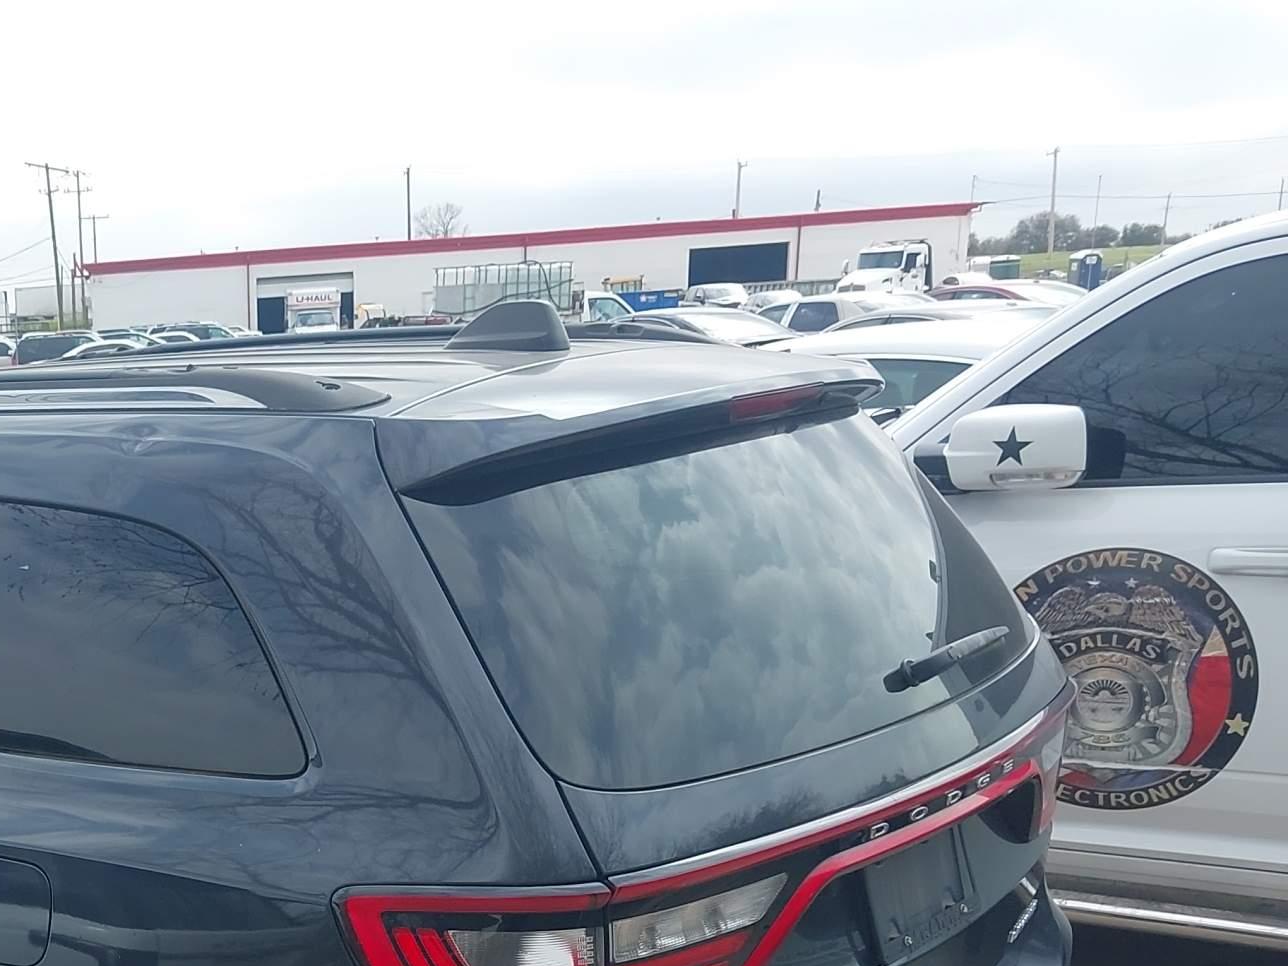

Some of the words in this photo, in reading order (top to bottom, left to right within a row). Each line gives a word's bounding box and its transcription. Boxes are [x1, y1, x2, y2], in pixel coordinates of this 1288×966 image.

[296, 295, 333, 303] U-HAUL
[1045, 551, 1163, 584] POWER
[1170, 563, 1254, 680] SPORTS
[1059, 634, 1160, 659] DALLAS
[869, 760, 1016, 839] DODGE
